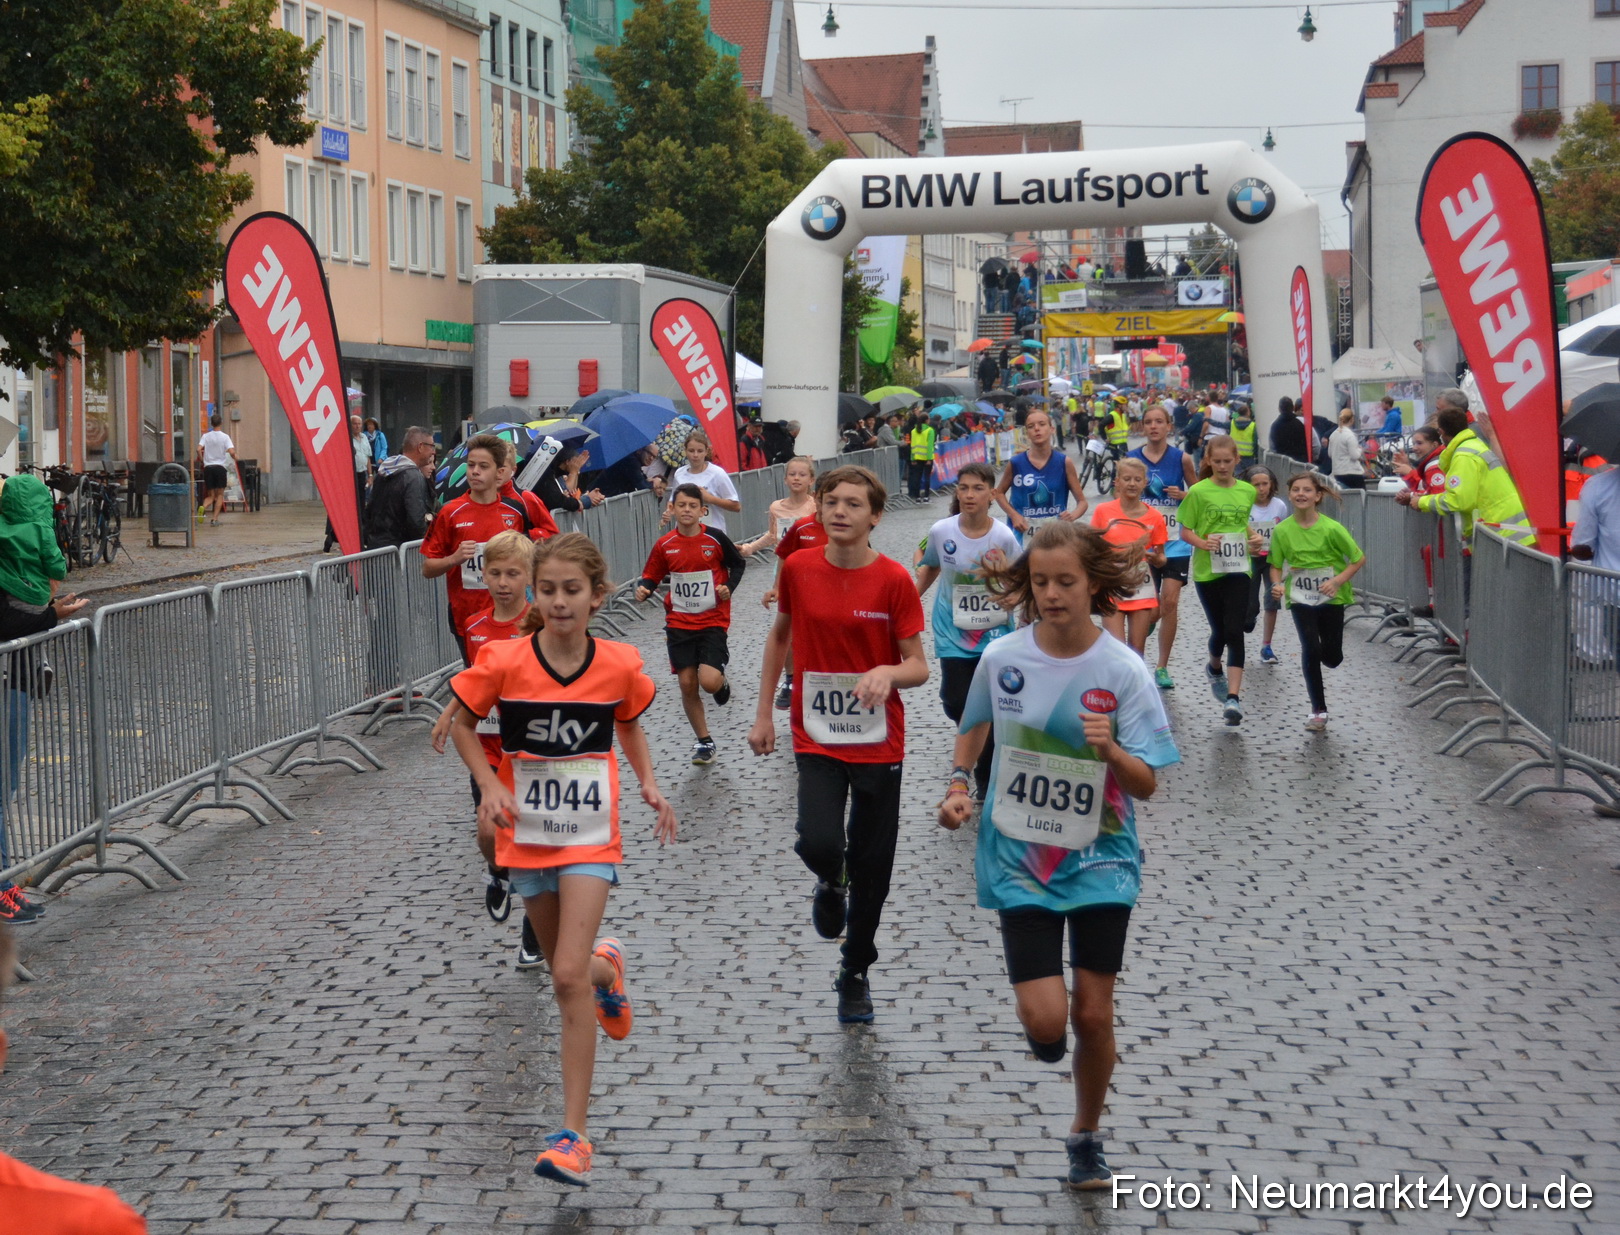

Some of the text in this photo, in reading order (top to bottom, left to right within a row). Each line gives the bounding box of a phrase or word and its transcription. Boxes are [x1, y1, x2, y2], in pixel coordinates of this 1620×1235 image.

[862, 163, 1210, 209] BMW Laufsport
[1440, 172, 1546, 412] REWE
[1115, 316, 1157, 331] ZIEL
[1293, 282, 1310, 394] REWE
[242, 244, 341, 455] REWE
[663, 315, 728, 421] REWE
[1013, 473, 1035, 487] 66
[1214, 541, 1245, 557] 4013
[675, 581, 709, 598] 4027
[859, 610, 867, 618] FC
[971, 616, 991, 624] Frank
[998, 697, 1024, 709] PARTL
[525, 709, 599, 751] sky
[829, 722, 862, 733] Niklas
[1046, 757, 1096, 775] BOCK
[524, 779, 602, 811] 4044
[1007, 772, 1094, 815] 4039
[543, 820, 578, 833] Marie
[1026, 815, 1063, 834] Lucia
